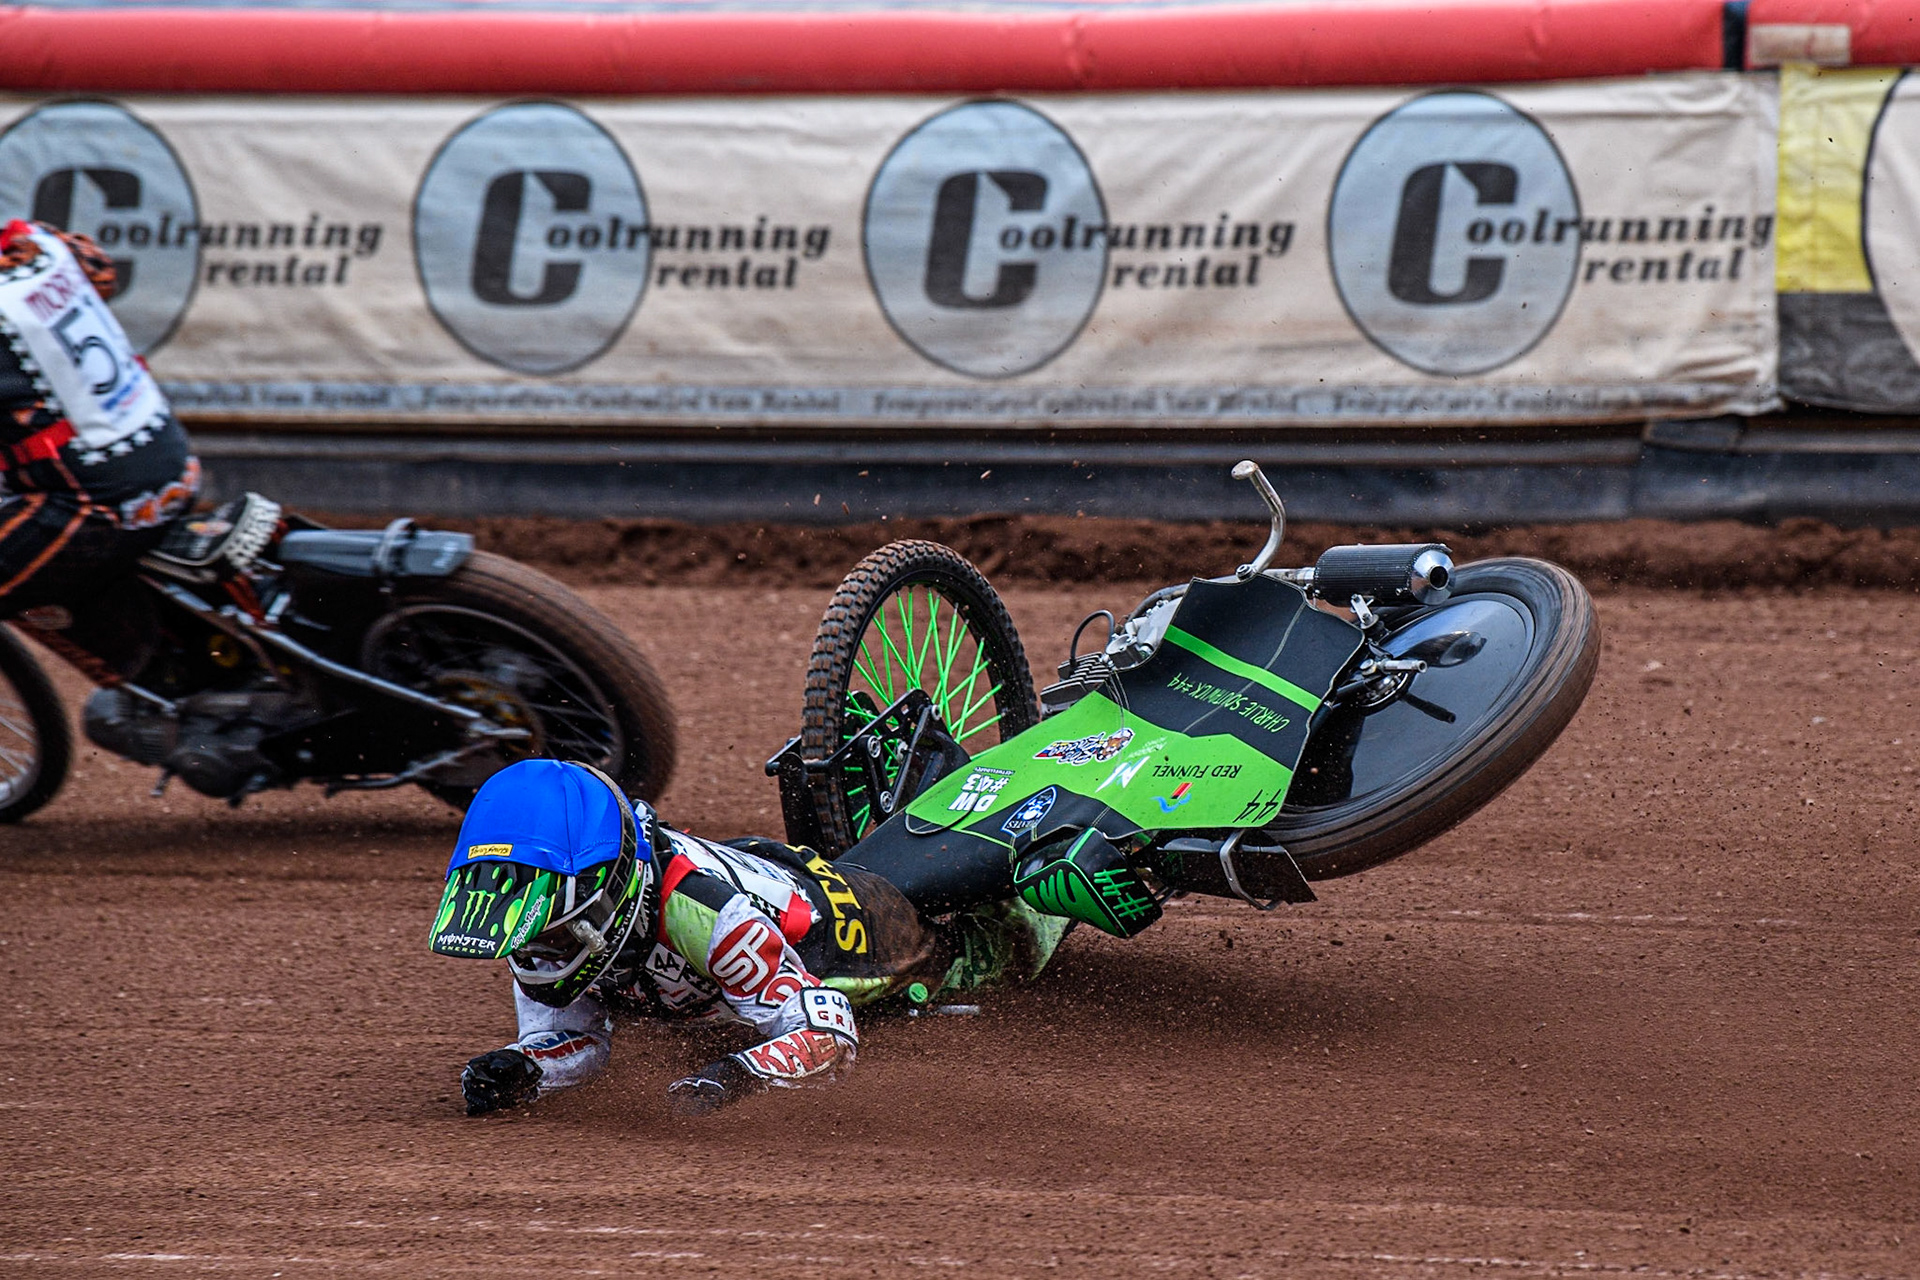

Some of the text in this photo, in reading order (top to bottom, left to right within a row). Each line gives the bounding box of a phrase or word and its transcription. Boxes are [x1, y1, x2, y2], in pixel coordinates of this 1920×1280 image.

[471, 170, 831, 307] Coolrunning
[923, 170, 1296, 309] Coolrunning
[1388, 160, 1775, 306] Coolrunning
[204, 256, 350, 286] rental
[653, 256, 799, 290] rental
[1112, 256, 1261, 288] rental
[1583, 248, 1744, 283] rental
[51, 306, 121, 396] 5
[1238, 701, 1290, 733] CHARLIE
[961, 772, 1010, 793] #43
[1152, 764, 1243, 779] RED FUNNEL
[947, 791, 999, 812] DW
[1233, 789, 1282, 824] 44
[1093, 868, 1153, 921] #44
[437, 932, 496, 952] MONSTER
[441, 945, 484, 955] ENERGY
[654, 952, 680, 973] 44
